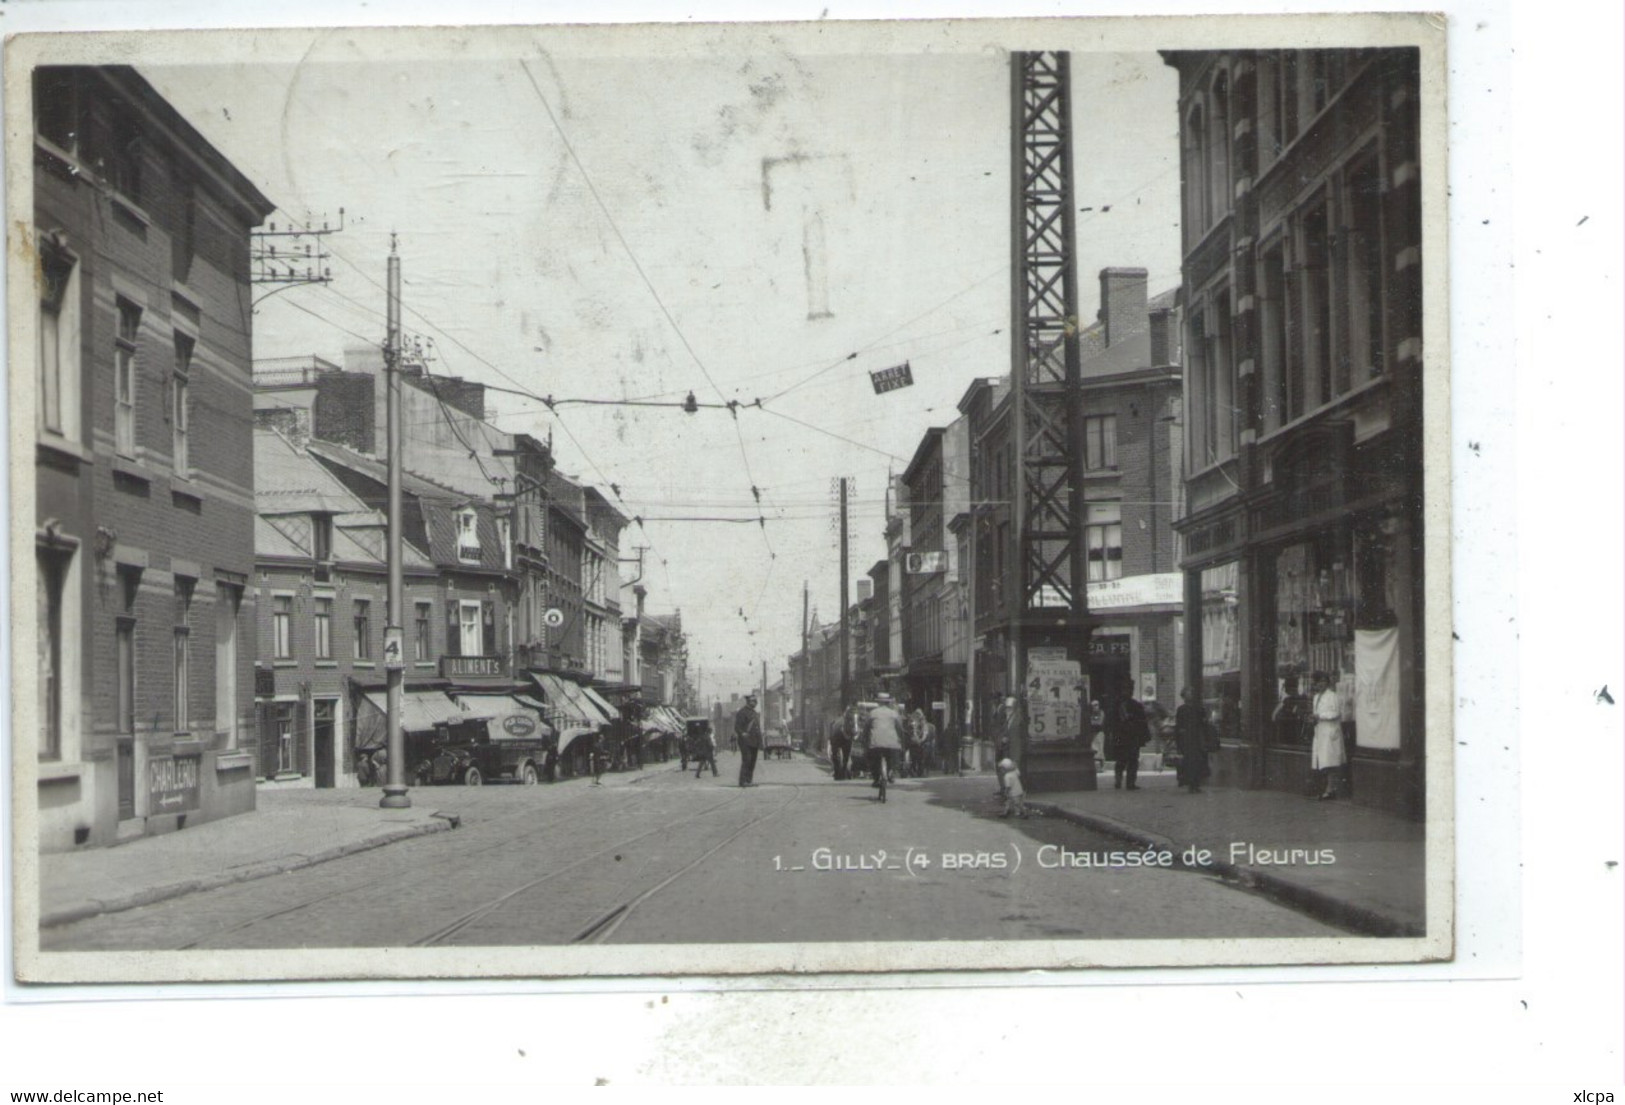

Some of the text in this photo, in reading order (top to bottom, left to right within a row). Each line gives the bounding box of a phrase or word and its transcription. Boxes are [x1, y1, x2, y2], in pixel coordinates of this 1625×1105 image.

[385, 641, 400, 655] 4
[1034, 713, 1046, 733] 5
[151, 759, 197, 793] CHARLEROI
